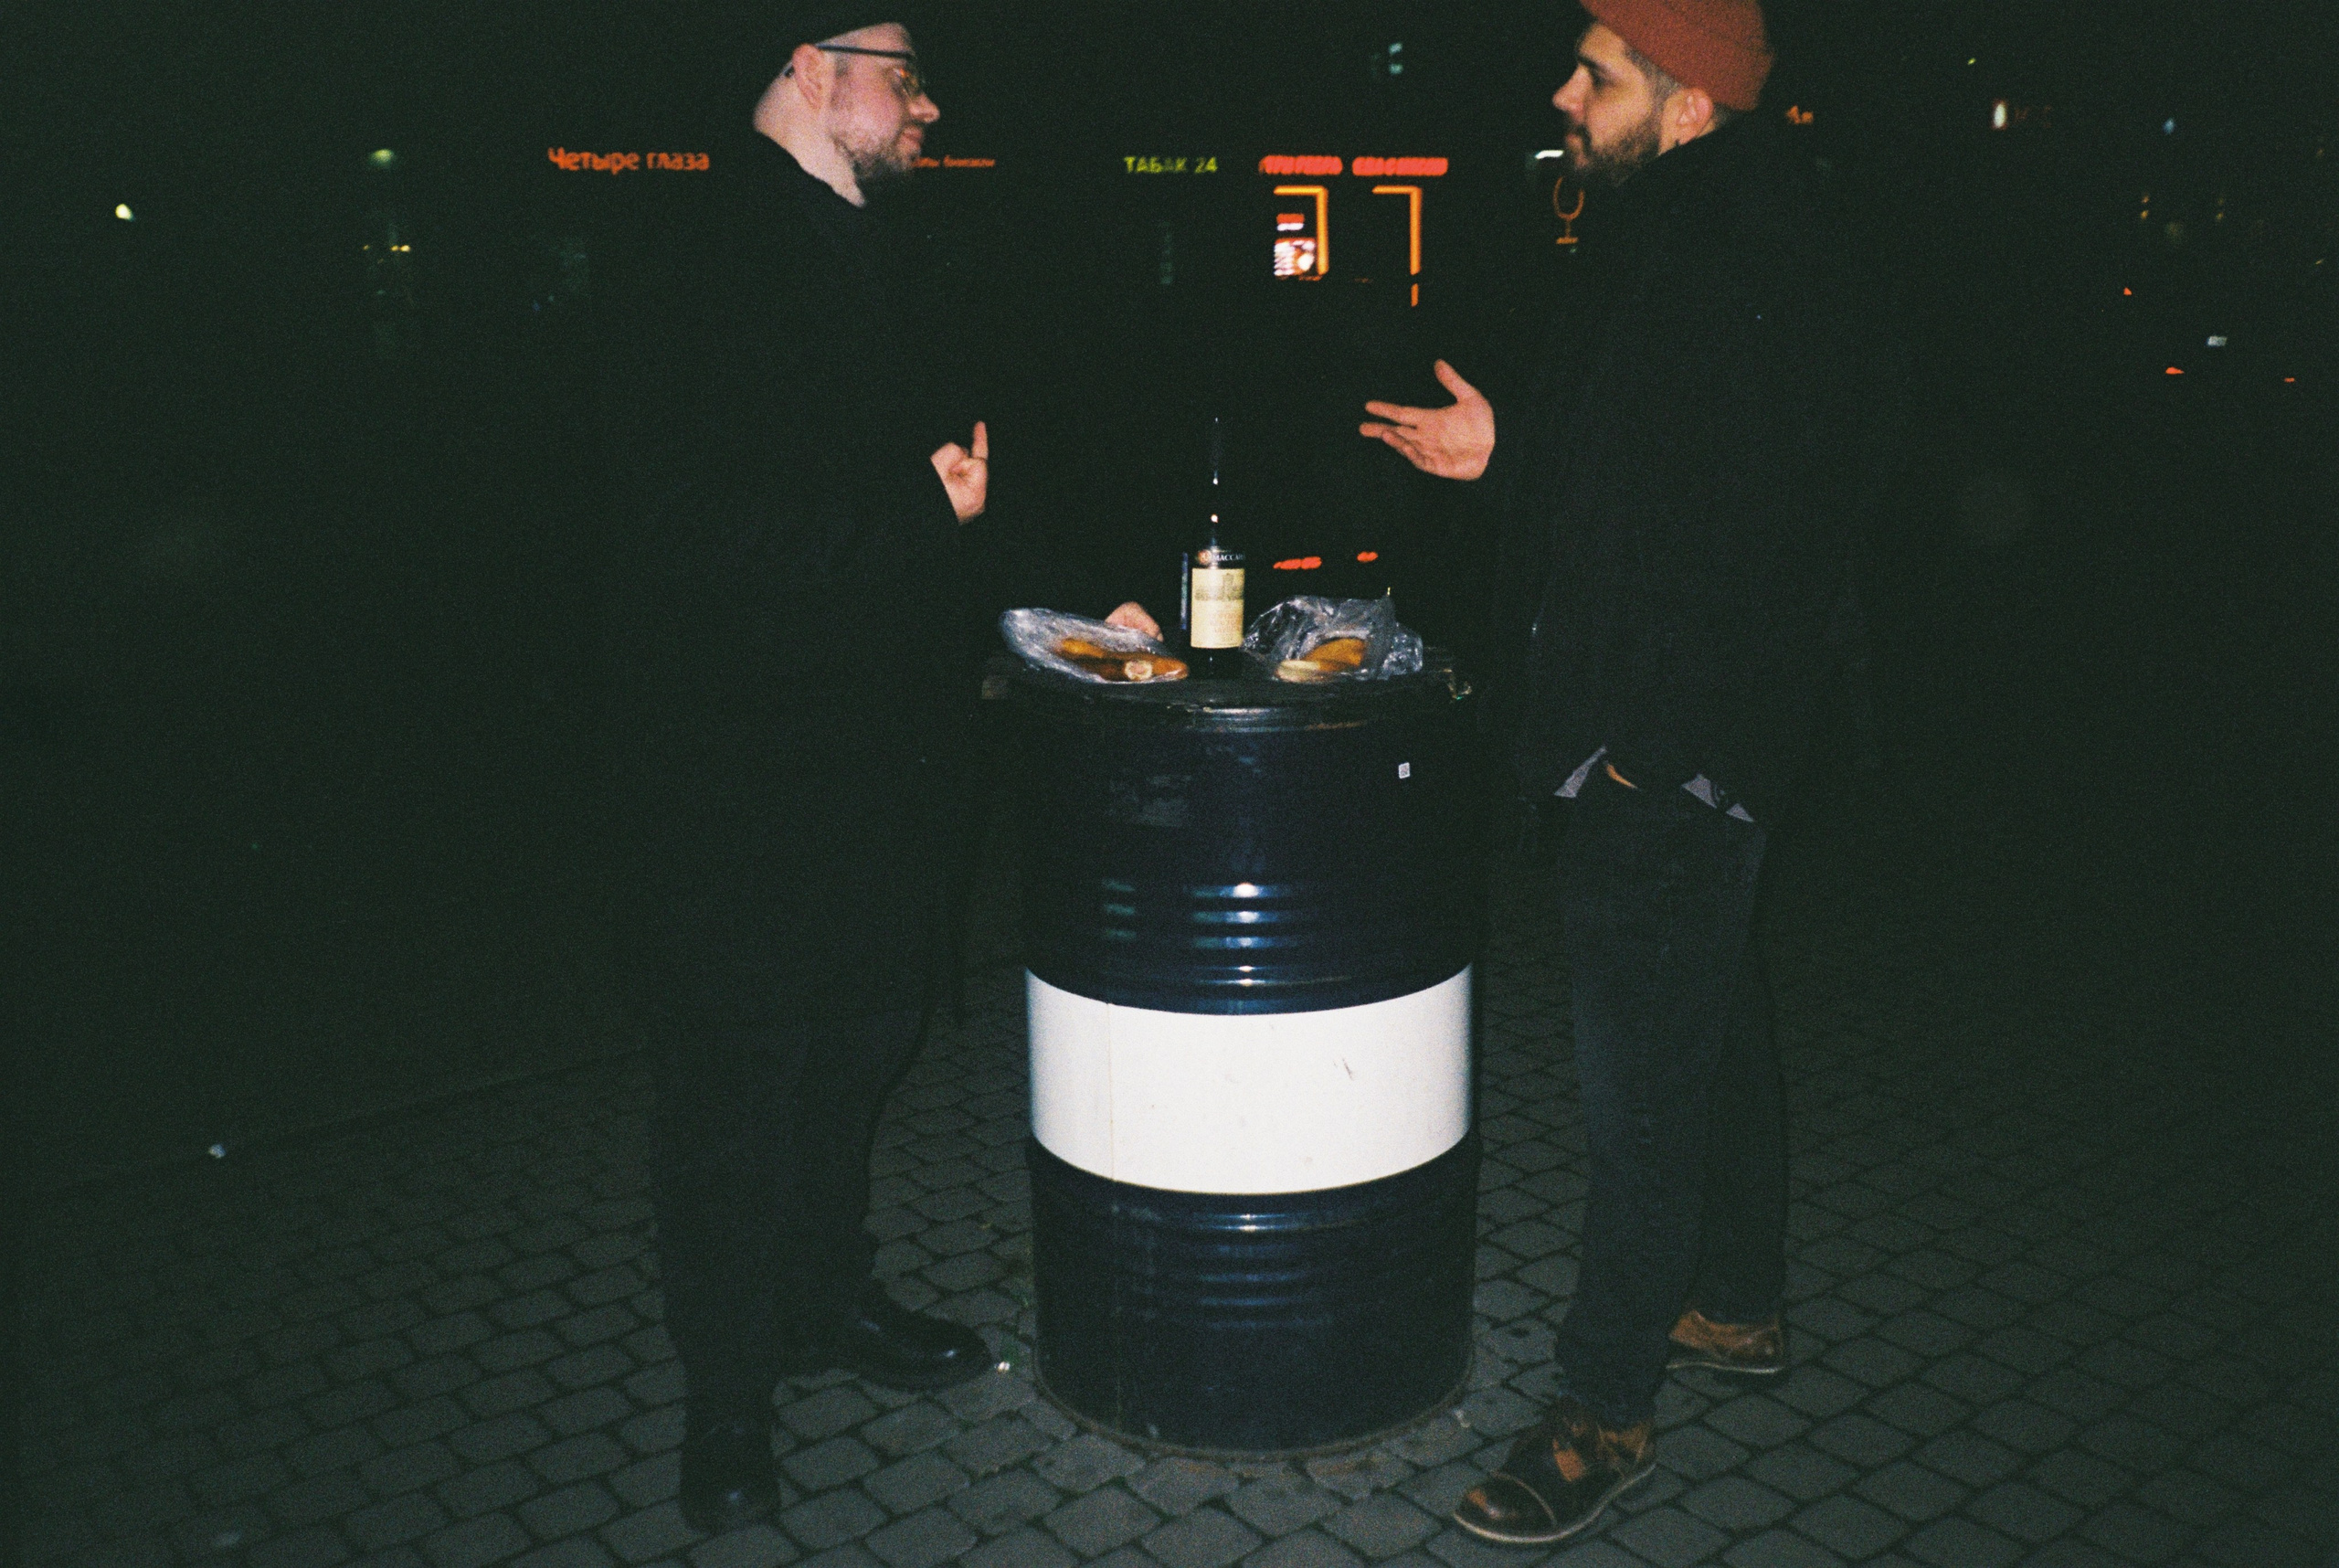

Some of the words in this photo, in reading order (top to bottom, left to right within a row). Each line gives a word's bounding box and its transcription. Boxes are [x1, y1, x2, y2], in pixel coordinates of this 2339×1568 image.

[547, 146, 640, 175] Четыре
[645, 152, 710, 172] глаза
[1123, 156, 1188, 174] ТАБАК
[1195, 156, 1218, 174] 24
